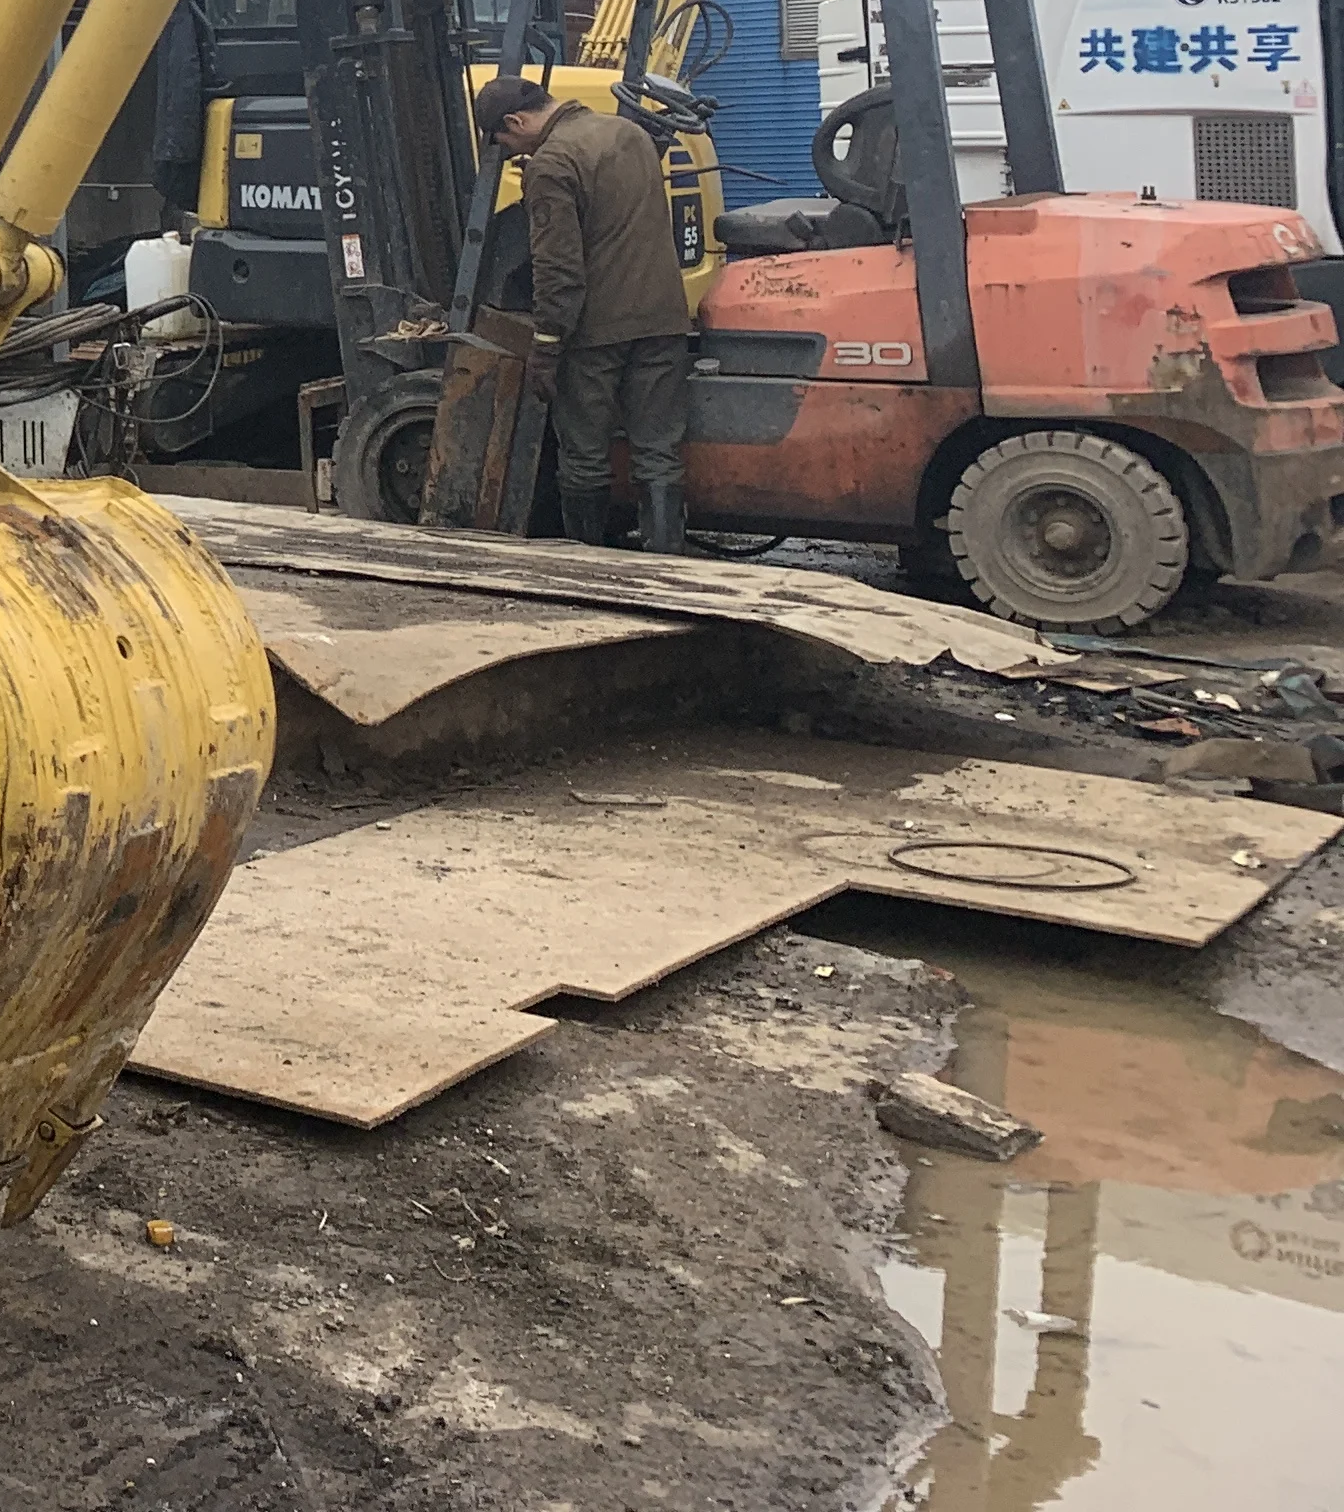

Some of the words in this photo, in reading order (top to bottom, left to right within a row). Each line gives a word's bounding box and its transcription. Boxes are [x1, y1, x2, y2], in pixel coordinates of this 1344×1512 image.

[1079, 24, 1301, 73] 共建共享
[684, 226, 698, 246] 55
[833, 341, 912, 366] 30
